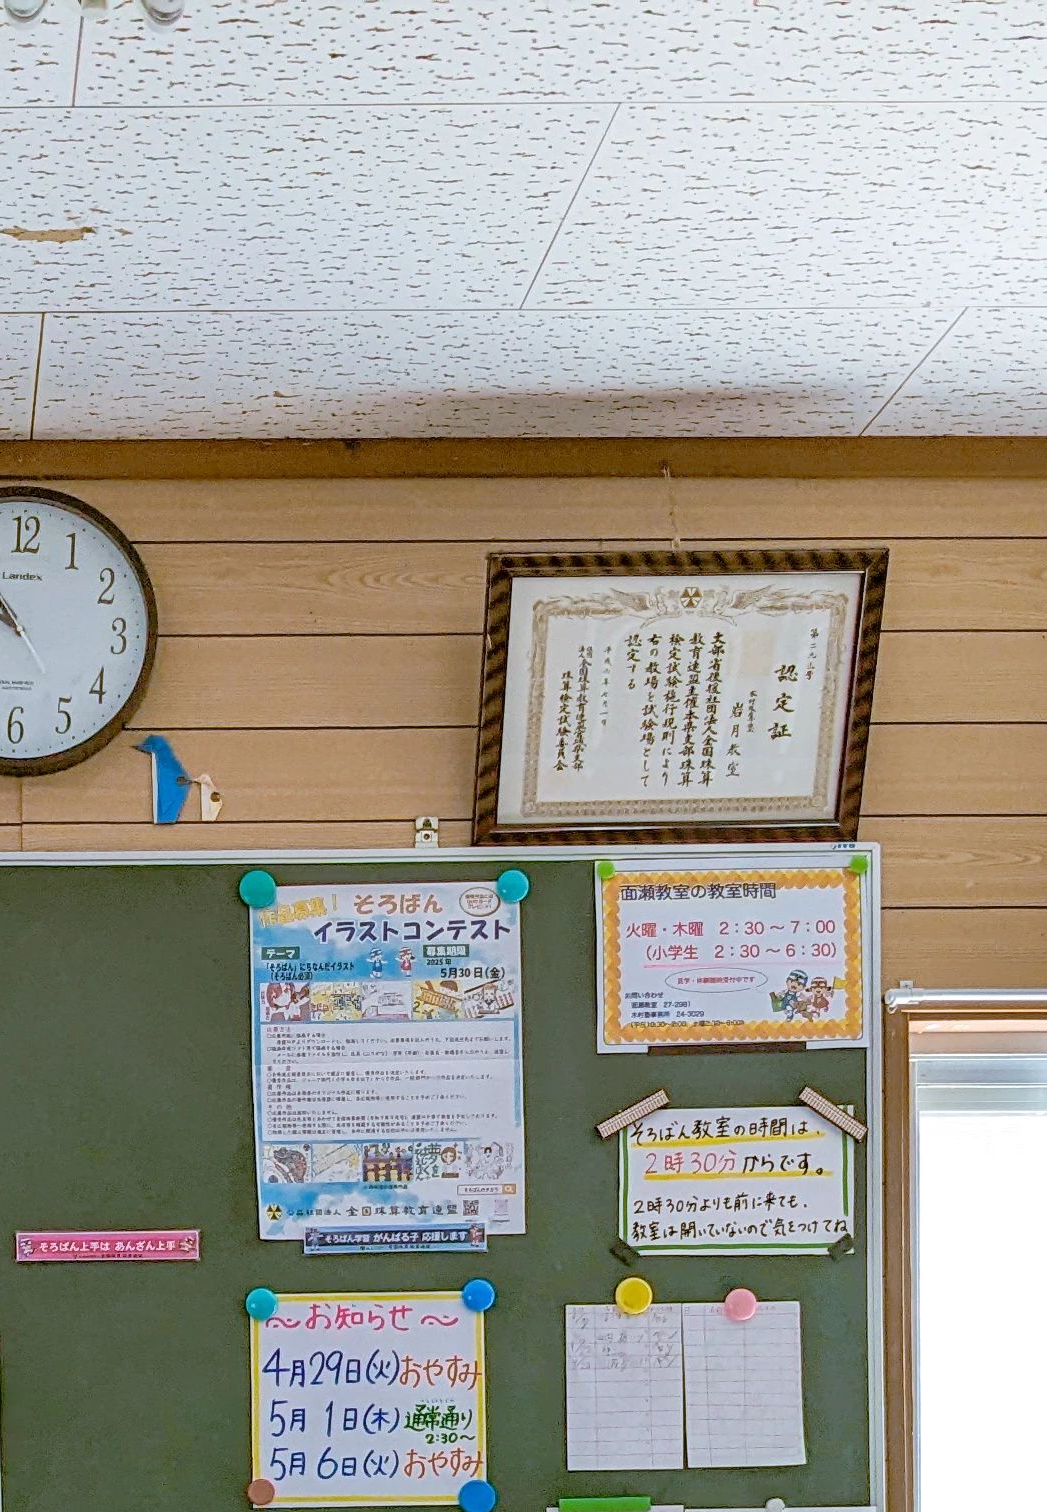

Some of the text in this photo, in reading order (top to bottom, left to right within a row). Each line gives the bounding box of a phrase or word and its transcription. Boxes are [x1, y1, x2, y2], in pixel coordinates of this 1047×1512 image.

[11, 516, 40, 553] 12
[65, 532, 79, 570] 1
[2, 572, 43, 582] Landex
[97, 568, 115, 605] 2
[110, 618, 126, 655] 3
[625, 634, 642, 690] 認定する
[89, 666, 106, 704] 4
[768, 664, 798, 740] 認定証
[8, 706, 24, 744] 6
[55, 696, 72, 734] 5
[725, 702, 743, 776] 岩月教室
[621, 882, 776, 900] 面瀬教室の教室時間
[354, 894, 443, 914] そろばん
[314, 920, 511, 942] イラストコンテスト
[626, 920, 835, 938] 火曜・木曜 2:30～7:00
[265, 948, 295, 958] テーマ
[646, 943, 837, 960] (小学生 2:30～6:30)
[441, 966, 505, 979] 5月30日(金)
[645, 1150, 825, 1176] 2時30分からです。
[346, 1203, 457, 1216] 全国珠算教育連盟
[373, 1232, 419, 1242] がんばる子
[421, 1231, 467, 1242] 応援します
[631, 1218, 847, 1242] 教室は開いていないので気をつけてね
[39, 1240, 175, 1252] そろばん上手は あんざん上手
